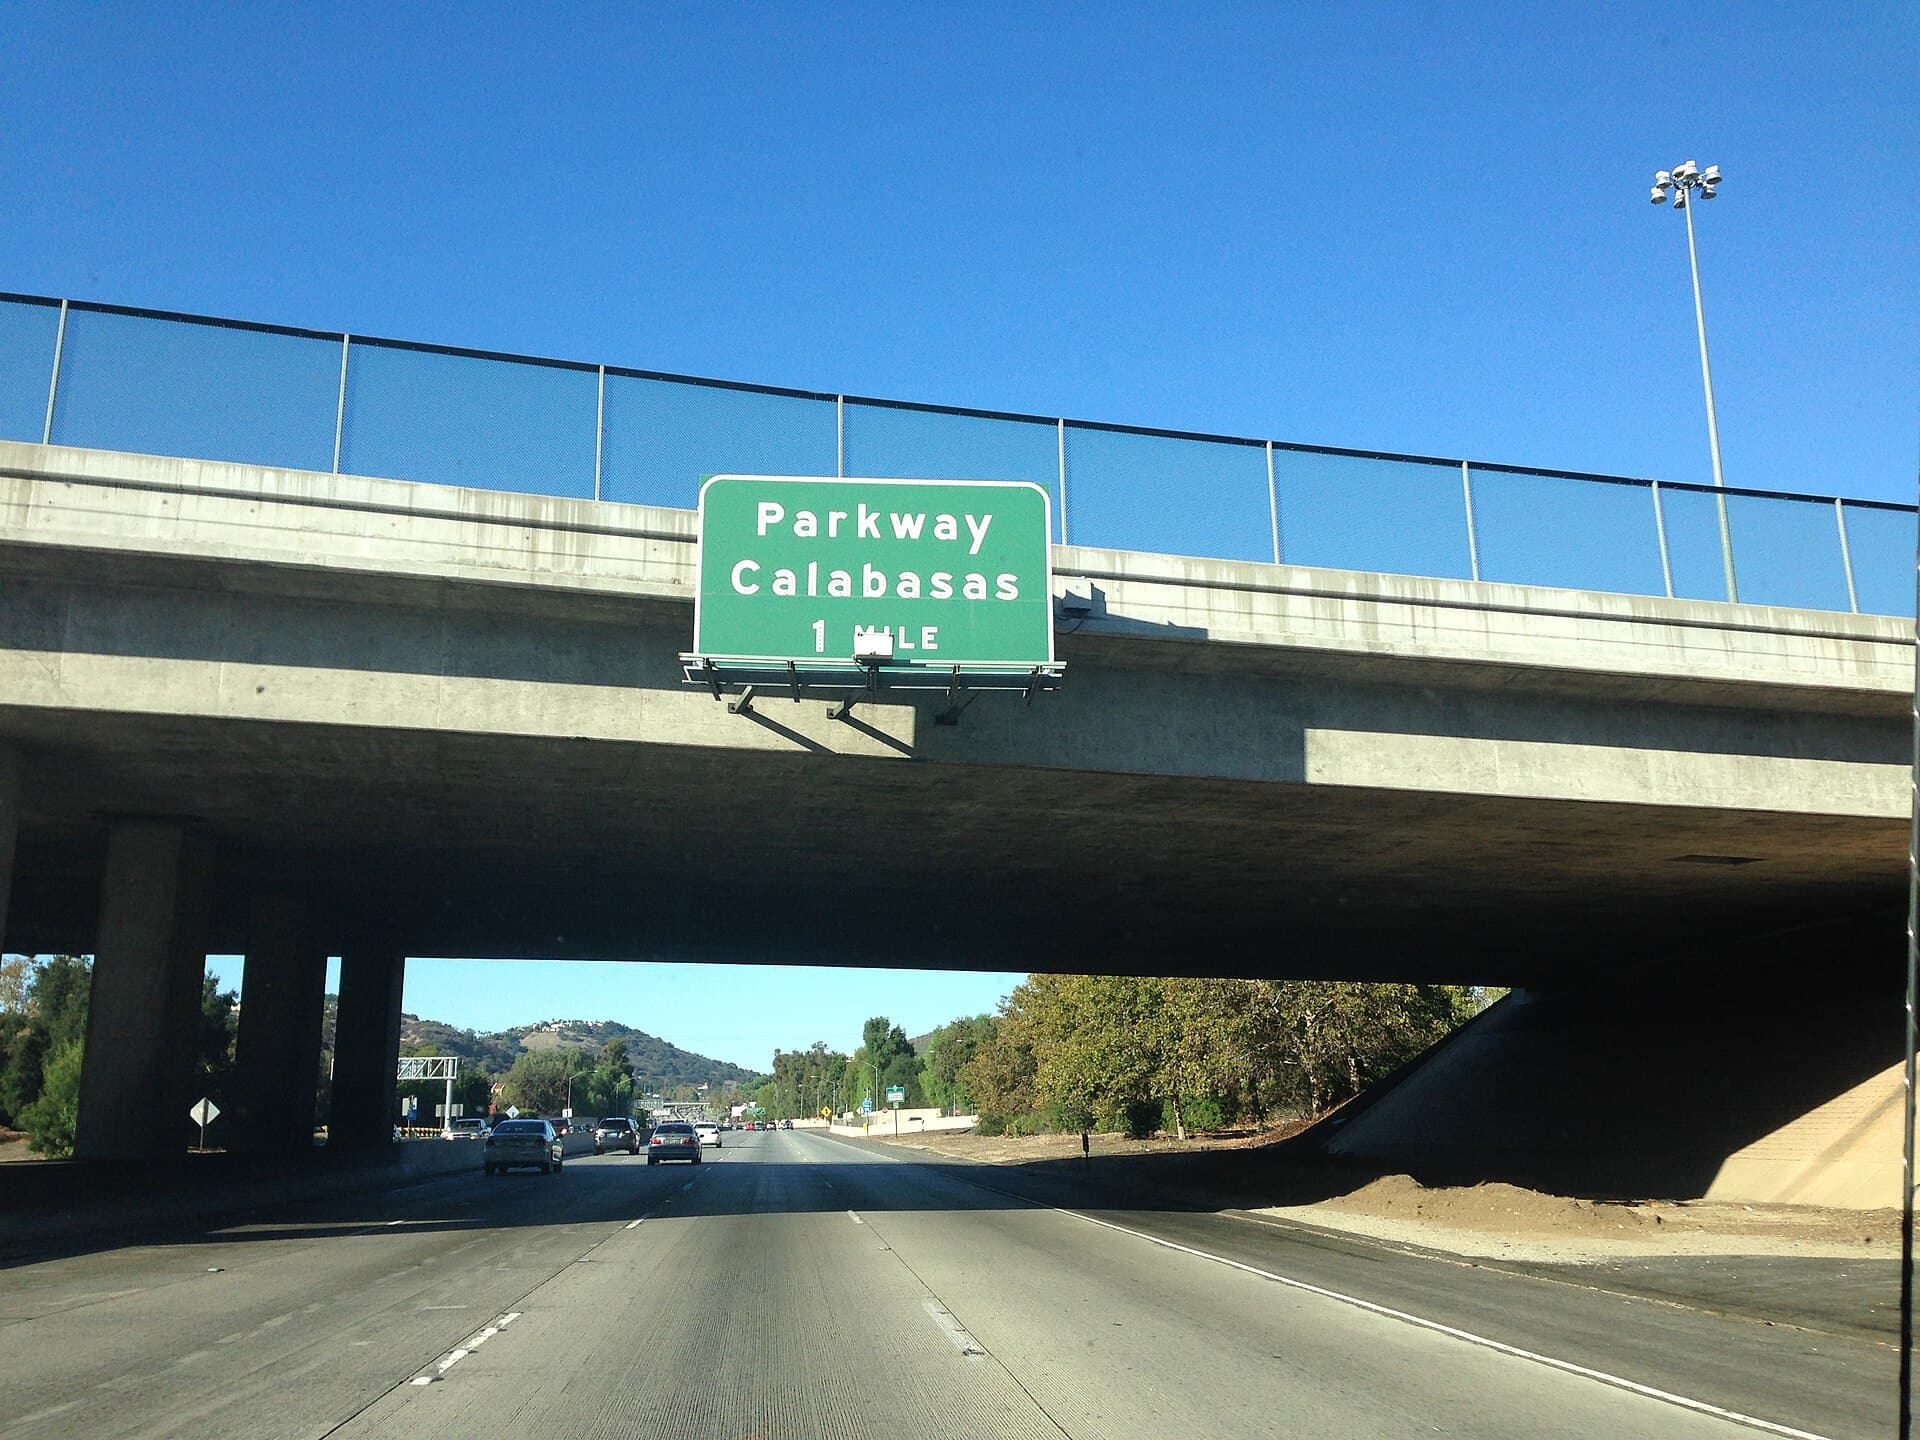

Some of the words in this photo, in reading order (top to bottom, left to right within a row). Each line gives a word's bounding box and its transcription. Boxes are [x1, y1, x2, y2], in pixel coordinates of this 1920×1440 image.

[756, 501, 993, 555] Parkway
[731, 559, 1019, 601] Calabasas
[811, 619, 825, 653] 1
